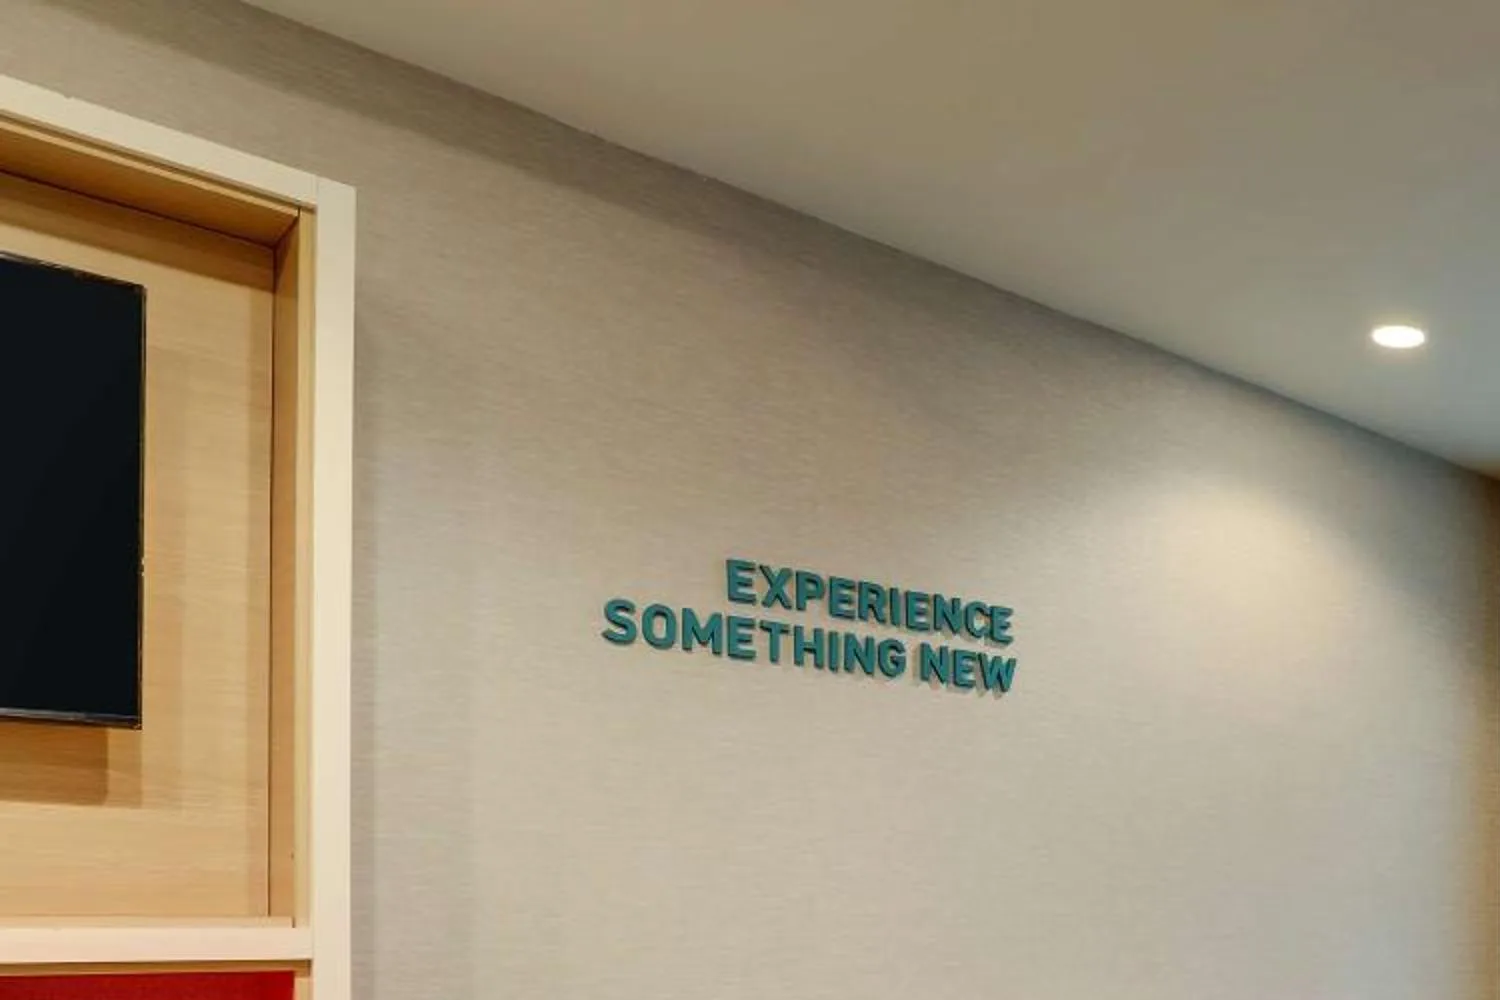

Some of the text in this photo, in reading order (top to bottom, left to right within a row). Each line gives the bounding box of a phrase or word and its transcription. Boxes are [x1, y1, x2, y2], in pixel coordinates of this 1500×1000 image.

[603, 599, 1017, 693] SOMETHING NEW
[726, 557, 1015, 646] EXPERIENCE
